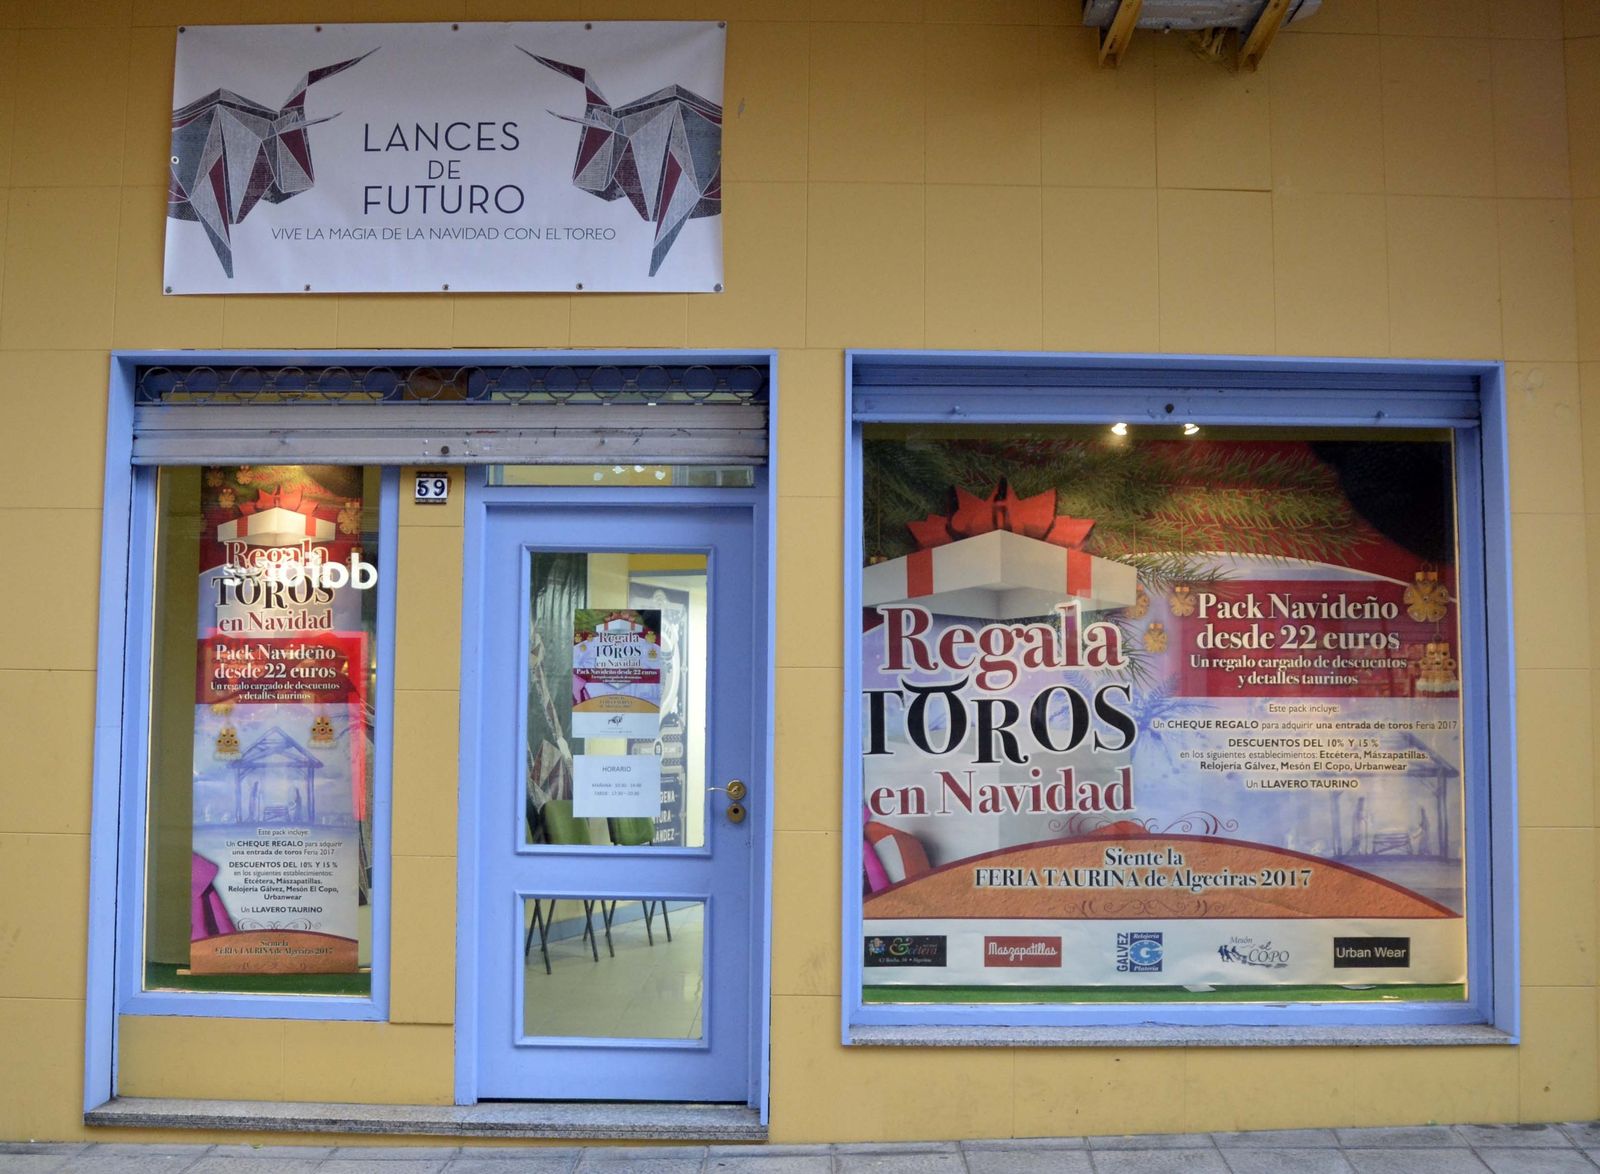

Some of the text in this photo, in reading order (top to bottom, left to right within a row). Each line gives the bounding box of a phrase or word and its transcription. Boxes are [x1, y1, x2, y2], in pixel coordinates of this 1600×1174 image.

[364, 122, 520, 152] LANCES
[428, 160, 461, 180] DE
[364, 184, 525, 215] FUTURO
[271, 228, 616, 240] VIVE LA MAGIA DE LA NAVIDAD CON EL TOREO
[416, 478, 446, 497] 59
[224, 539, 330, 579] Regala
[212, 568, 335, 609] TOROS
[1197, 593, 1399, 619] Pack Navideño
[218, 609, 333, 632] en Navidad
[600, 632, 639, 646] Regala
[1196, 624, 1400, 649] desde 22 euros
[215, 643, 337, 660] Pack Navideño
[595, 645, 642, 659] TOROS
[879, 602, 1127, 691] Regala
[214, 663, 337, 679] desde 22 euros
[1189, 655, 1408, 672] Un regalo cargado de descuentos
[210, 681, 340, 692] Un regalo cargado de descuentos
[1238, 671, 1358, 688] y detalles taurinos
[1269, 704, 1286, 712] Este
[1288, 704, 1307, 715] pack
[863, 675, 1136, 764] TOROS
[1153, 721, 1165, 729] Un
[1167, 720, 1212, 730] CHEQUE
[1215, 720, 1259, 729] REGALO
[1261, 722, 1279, 731] para
[1282, 721, 1313, 731] adquirir
[1335, 721, 1371, 729] entrada
[1374, 721, 1386, 729] de
[1388, 721, 1413, 729] toros
[1437, 721, 1457, 729] 2017
[1228, 739, 1379, 748] DESCUENTOS DEL 10% Y 15 %
[1192, 750, 1204, 758] los
[1206, 750, 1246, 760] siguientes
[1249, 750, 1318, 758] establecimientos:
[1320, 750, 1361, 759] Etcétera,
[1200, 762, 1408, 772] Relojería Gálvez, Mesón El Copo, Urbanwear
[870, 767, 1135, 816] en Navidad
[1246, 780, 1359, 788] Un LLAVERO TAURINO
[1104, 848, 1183, 866] Siente la
[975, 869, 1312, 892] FERIA TAURINA de Algeciras 2017
[988, 942, 1058, 961] Maszapatillas
[1116, 932, 1129, 972] GALVEZ
[1249, 949, 1290, 963] COPO
[1336, 947, 1407, 958] Urban Wear
